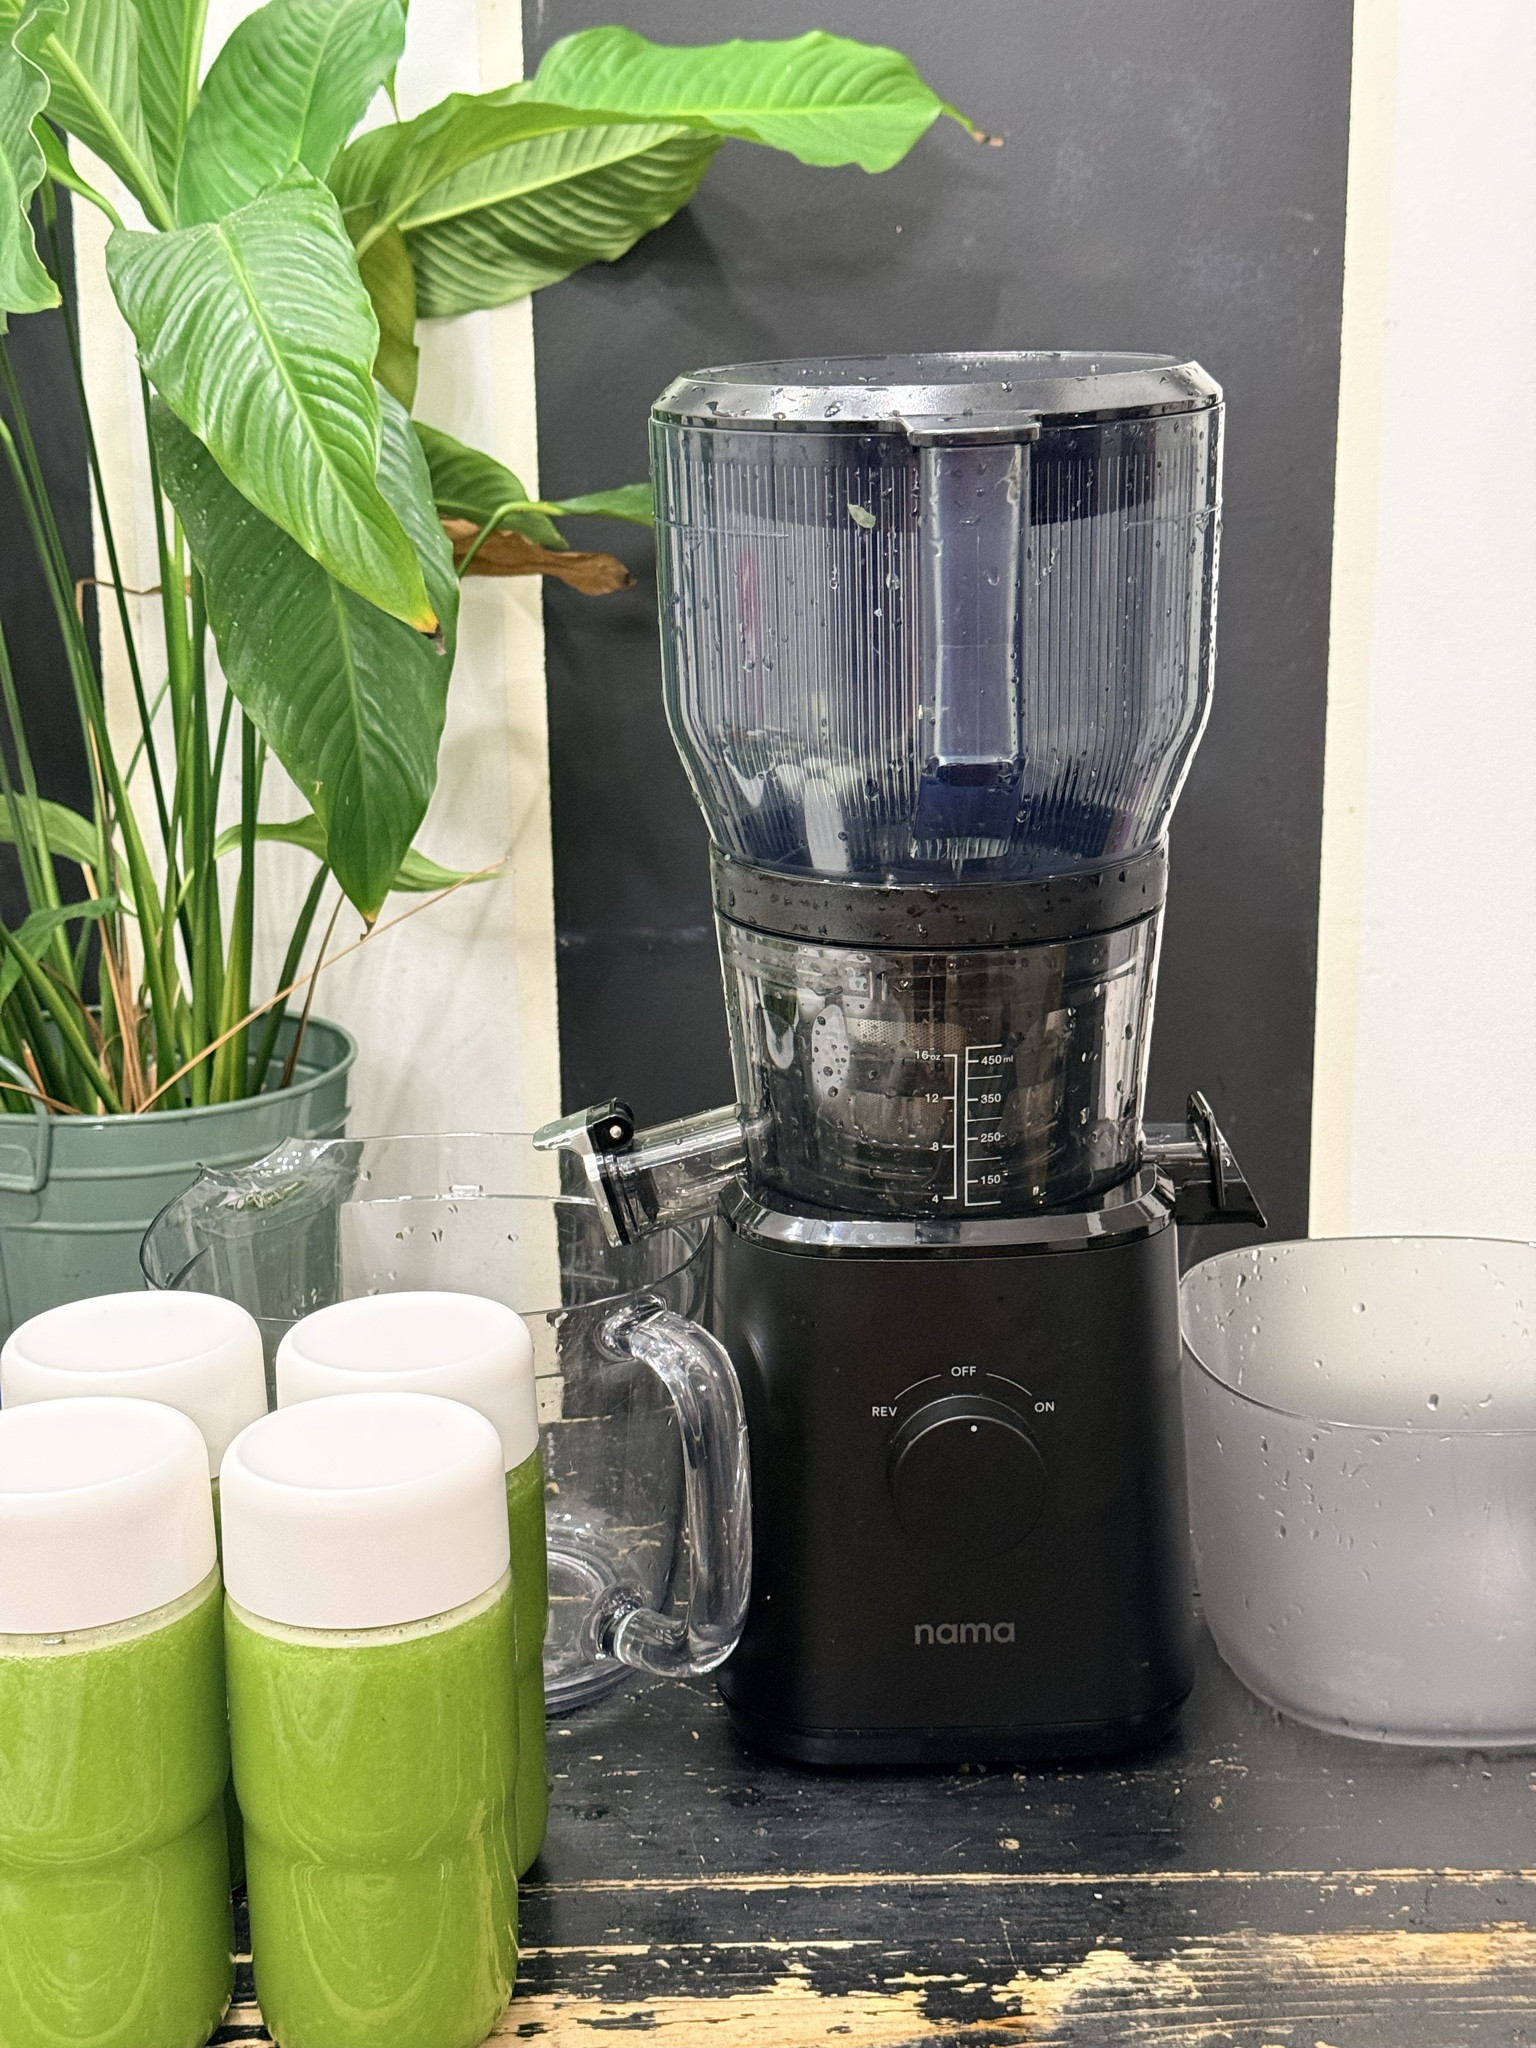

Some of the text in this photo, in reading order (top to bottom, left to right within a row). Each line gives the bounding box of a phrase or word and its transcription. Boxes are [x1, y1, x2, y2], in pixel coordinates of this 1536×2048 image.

[925, 1093, 939, 1103] 12
[980, 1093, 1002, 1104] 350
[980, 1132, 1001, 1143] 250
[932, 1142, 939, 1152] 8
[980, 1174, 1001, 1185] 150
[932, 1194, 939, 1203] 4
[951, 1366, 977, 1377] OFF
[872, 1406, 898, 1417] REV
[1034, 1401, 1055, 1413] ON
[914, 1622, 1015, 1645] nama
